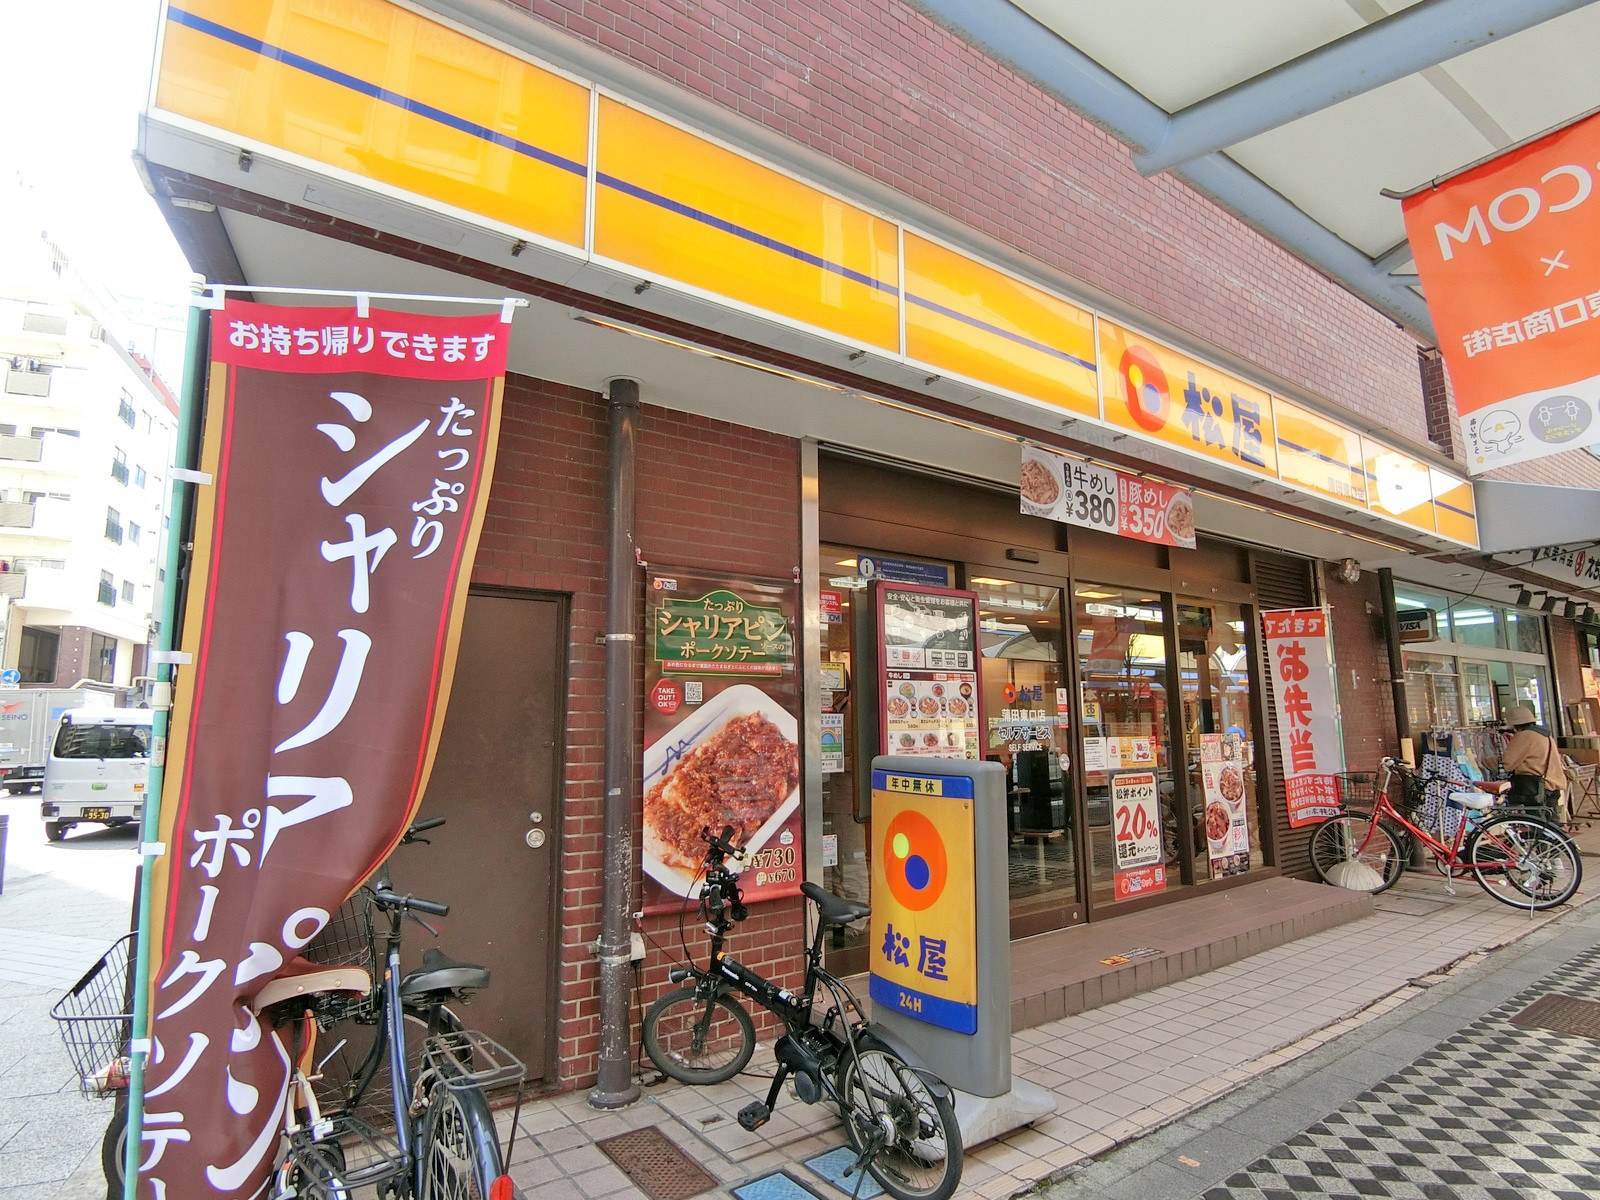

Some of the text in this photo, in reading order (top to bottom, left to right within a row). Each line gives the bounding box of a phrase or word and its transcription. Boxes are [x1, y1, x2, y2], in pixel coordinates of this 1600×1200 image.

[229, 320, 496, 363] お持ち帰りできます
[1182, 371, 1266, 467] 松屋
[411, 396, 476, 560] たっぷり
[1073, 466, 1114, 495] 牛めし
[1128, 481, 1168, 507] 豚めし
[1066, 490, 1116, 527] ¥380
[1121, 505, 1165, 539] ¥350
[704, 598, 744, 614] たっぷり
[659, 610, 785, 641] シャリアピン
[1399, 622, 1421, 630] VISA
[680, 641, 766, 661] ポークソテー
[760, 642, 784, 650] ソースの
[1019, 685, 1043, 702] 松屋
[1001, 708, 1046, 722] 蒲田東口店
[998, 726, 1051, 740] セルフサービス
[1009, 743, 1043, 752] SELF SERVICE
[891, 776, 935, 793] 年中無休
[1116, 787, 1153, 800] 松弁ポイント
[1116, 803, 1158, 842] 20%
[753, 847, 795, 868] ¥730
[768, 868, 795, 883] ¥670
[882, 923, 948, 981] 松屋
[899, 991, 922, 1013] 24H
